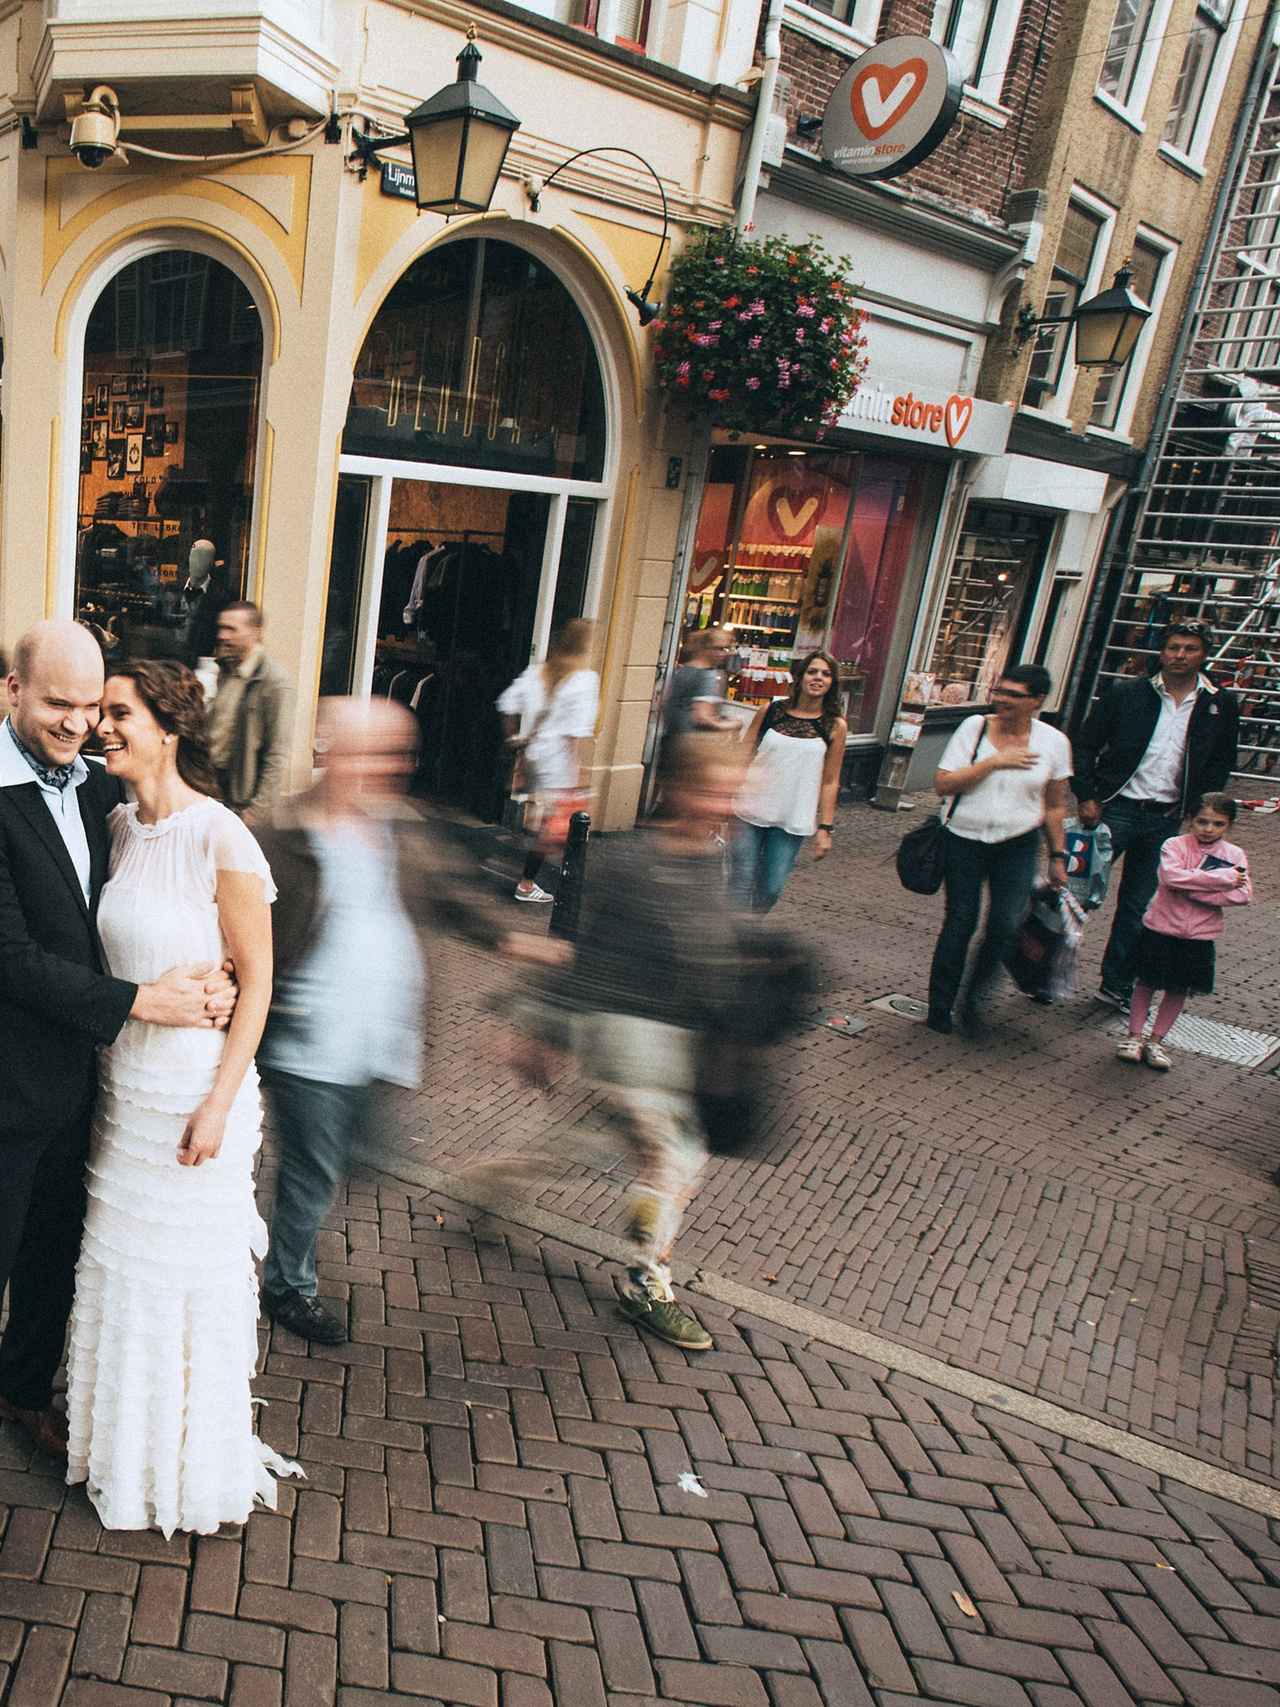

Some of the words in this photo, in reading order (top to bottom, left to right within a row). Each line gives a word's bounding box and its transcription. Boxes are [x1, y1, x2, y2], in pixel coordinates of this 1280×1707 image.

[833, 143, 905, 159] vitaminstore
[388, 162, 415, 186] Lijnm
[842, 383, 944, 433] minstore
